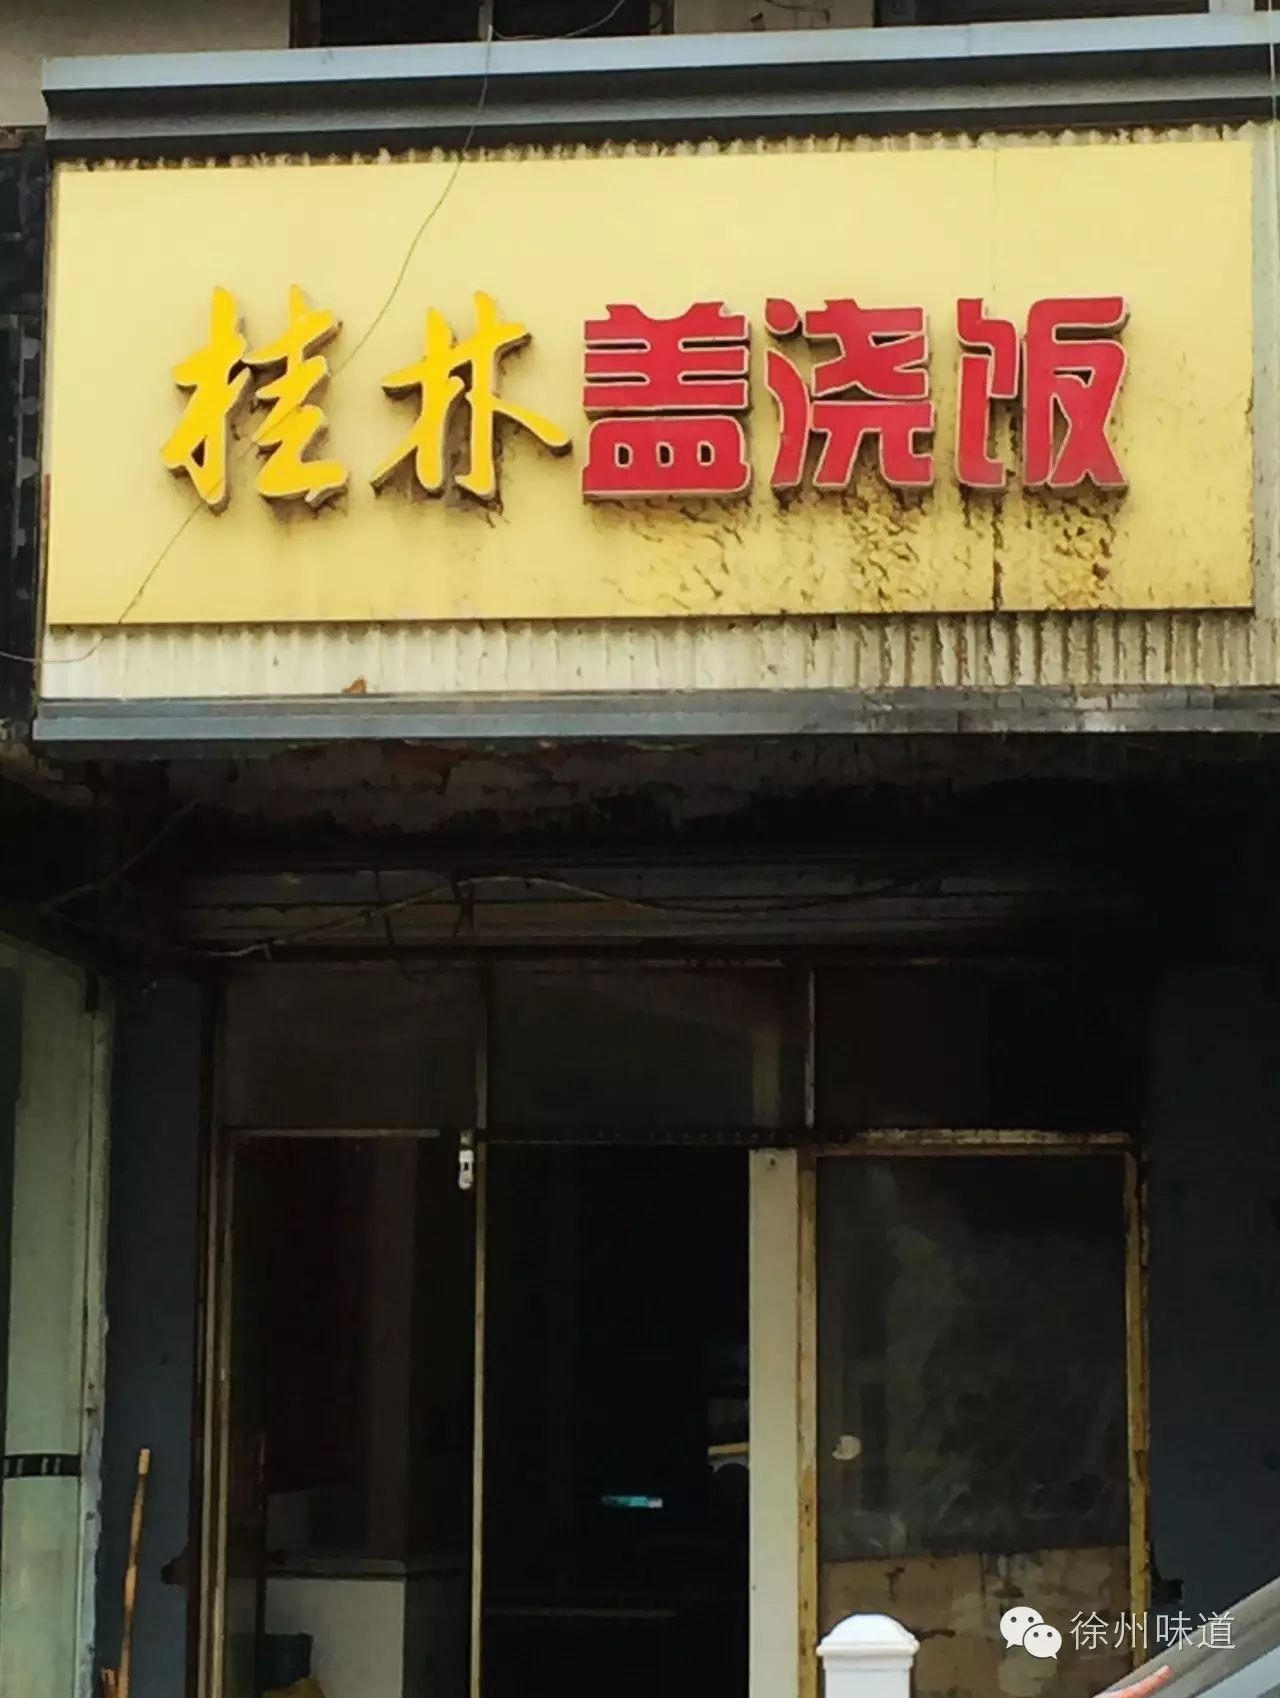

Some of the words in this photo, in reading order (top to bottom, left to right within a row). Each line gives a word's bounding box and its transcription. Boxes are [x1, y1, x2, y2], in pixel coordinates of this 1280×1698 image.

[160, 285, 1129, 508] 桂林盖浇饭
